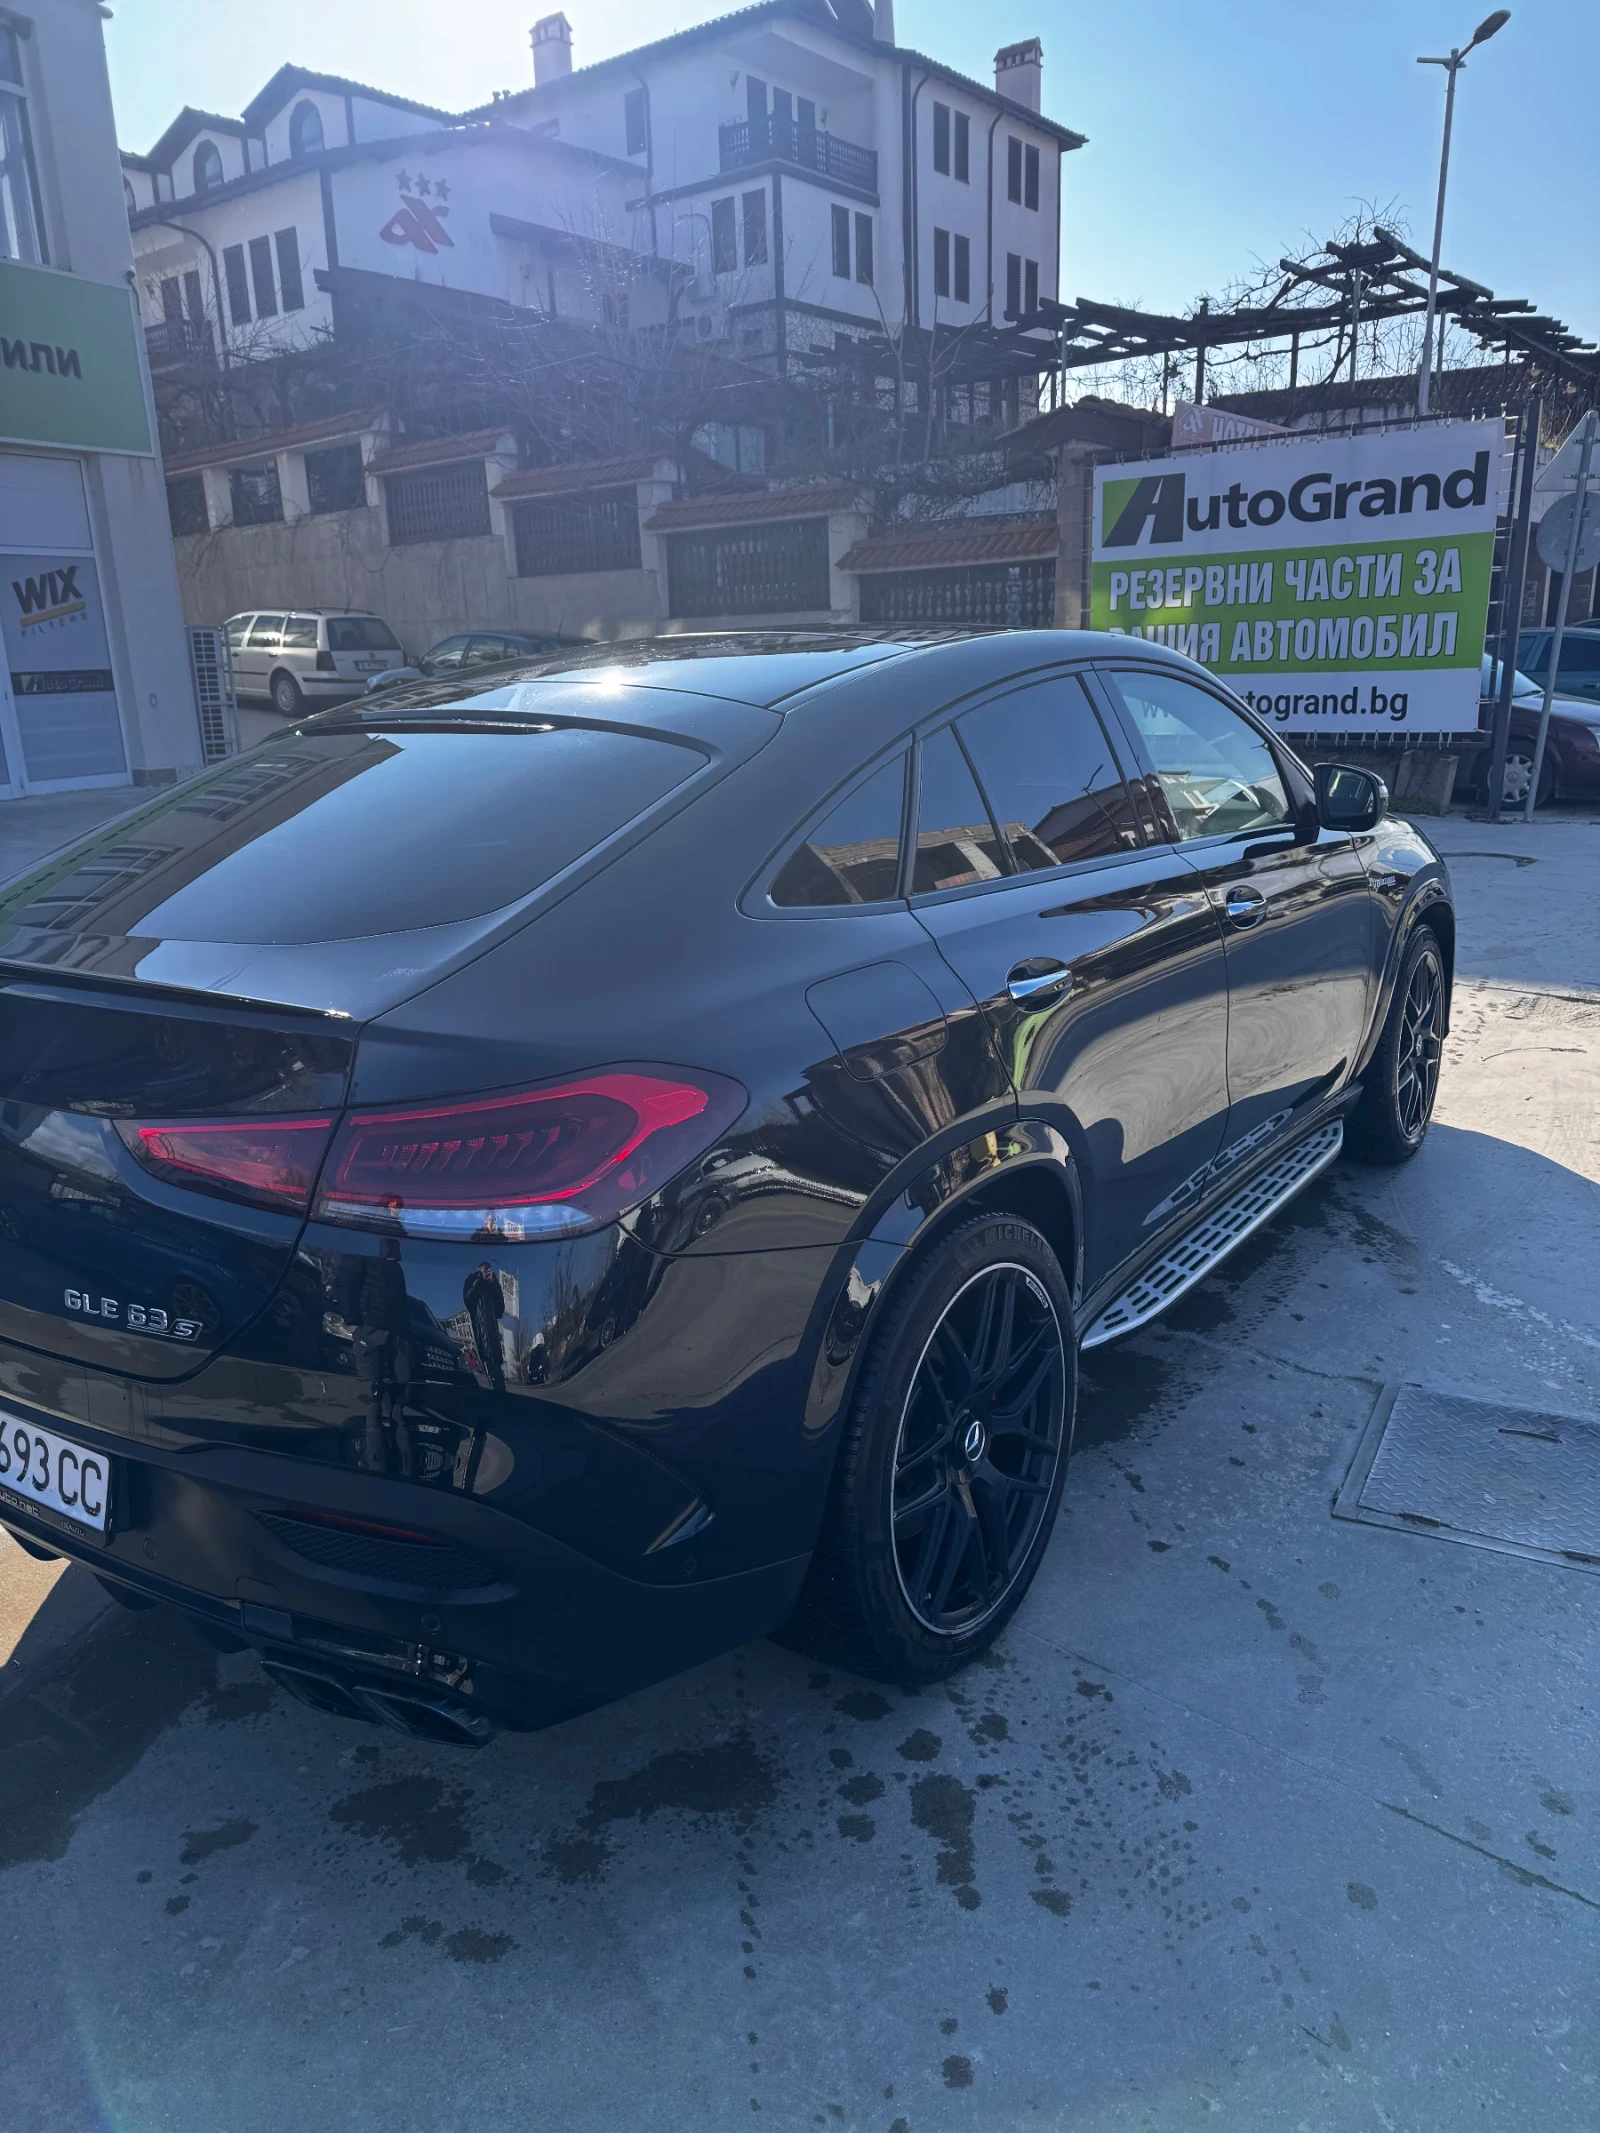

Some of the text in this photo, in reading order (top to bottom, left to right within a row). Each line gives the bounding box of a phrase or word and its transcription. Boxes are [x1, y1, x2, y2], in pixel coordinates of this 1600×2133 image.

[1102, 451, 1490, 548] AutoGrand
[12, 564, 84, 615] WIX
[1109, 548, 1463, 611] РЕЗЕРВНИ ЧАСТИ ЗА
[21, 611, 88, 639] FILTERS
[1230, 611, 1458, 662] АВТОМОБИЛ
[1240, 686, 1408, 721] togrand.bg
[985, 1225, 1051, 1256] MICHELIN
[64, 1288, 120, 1319] GLE
